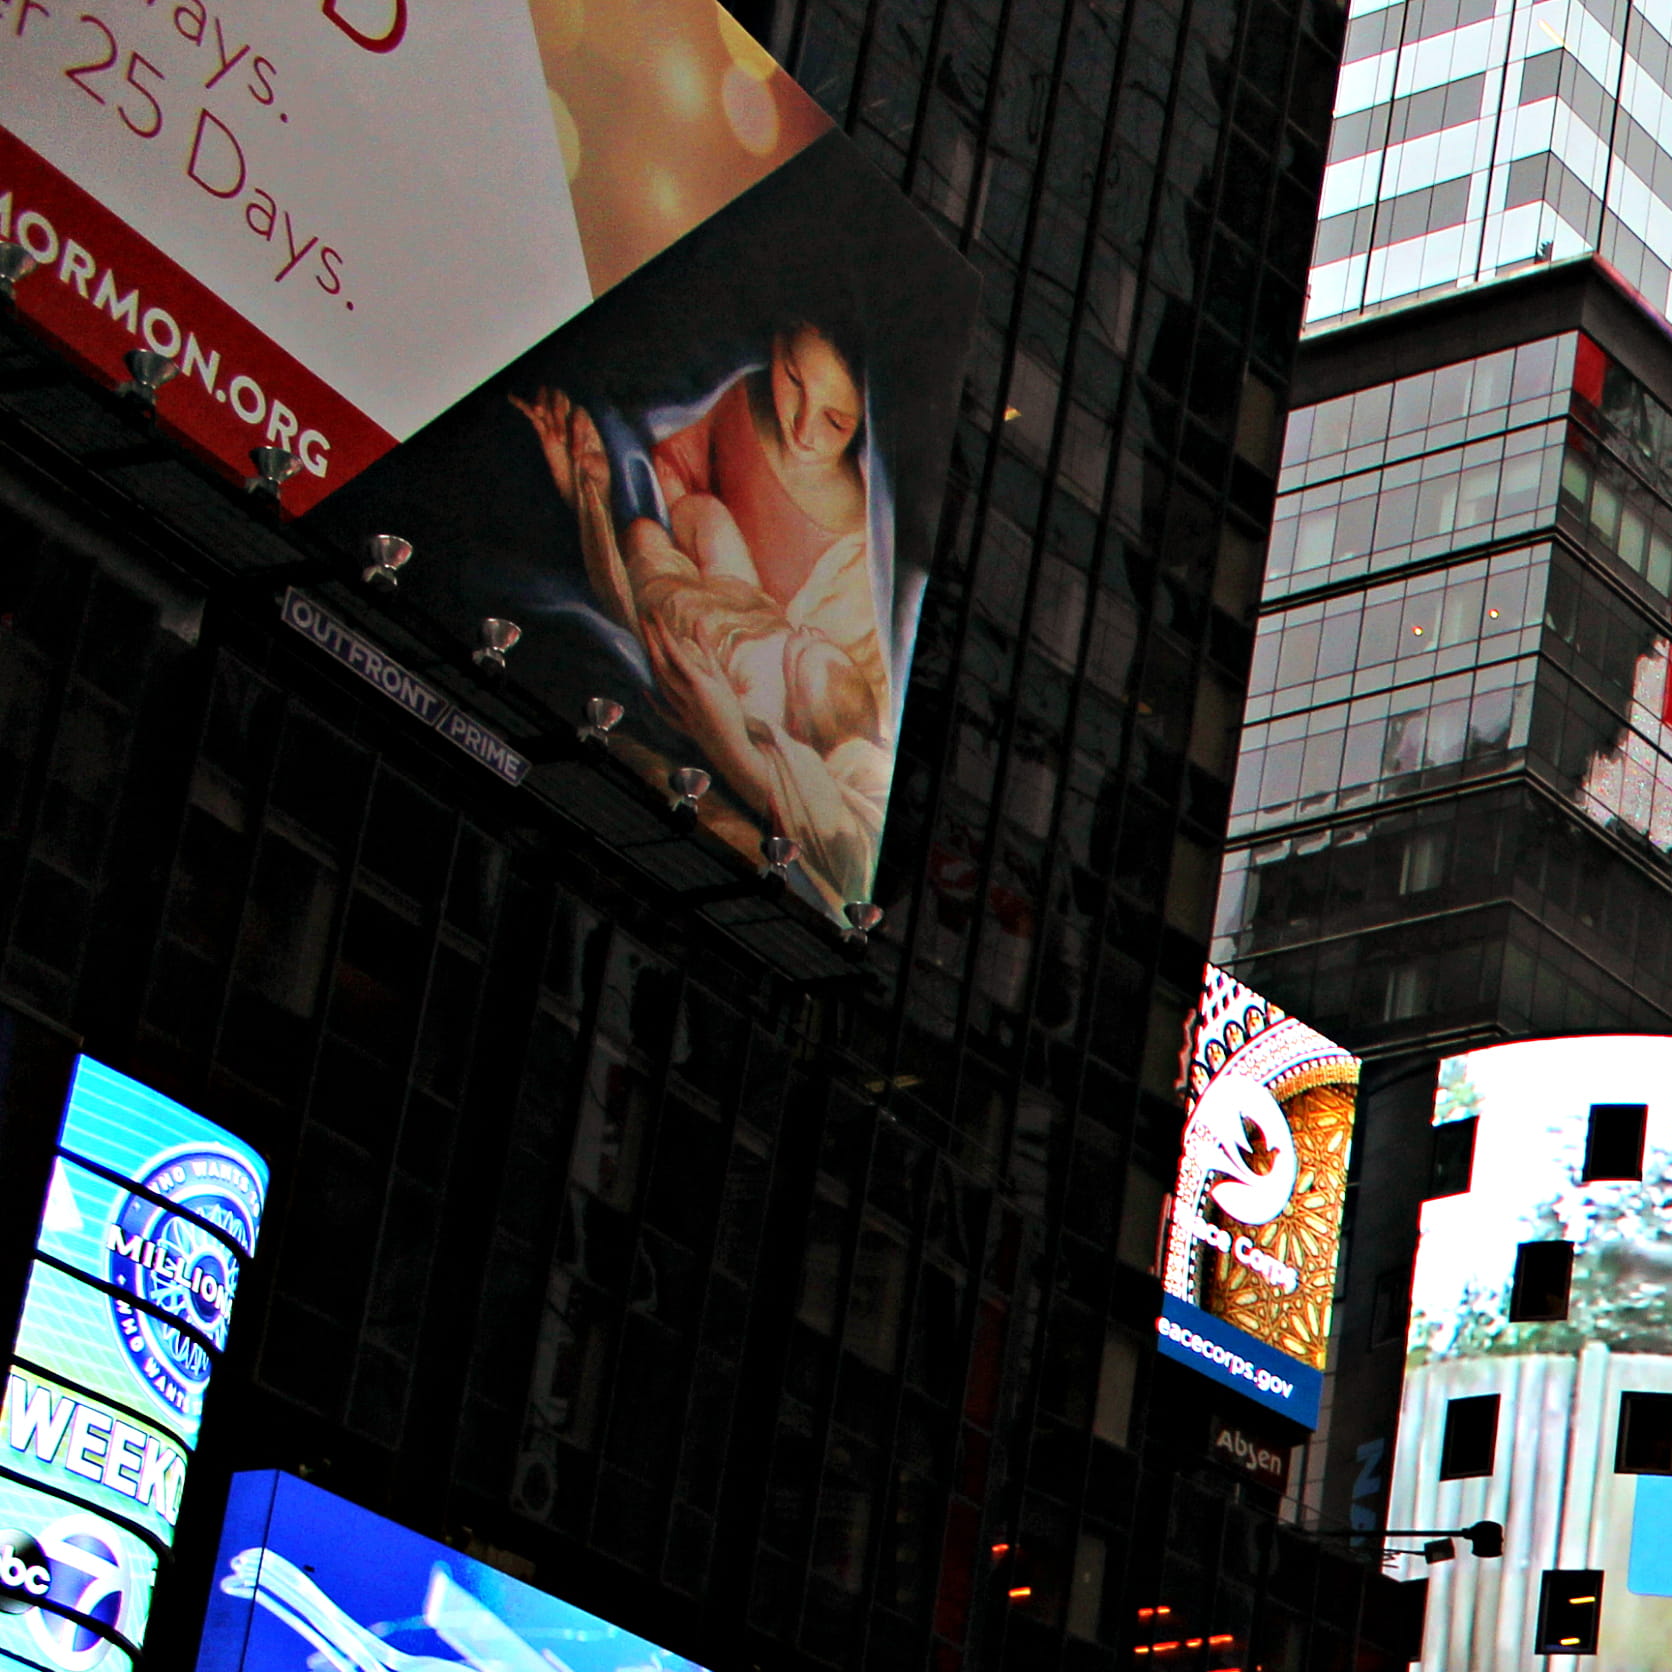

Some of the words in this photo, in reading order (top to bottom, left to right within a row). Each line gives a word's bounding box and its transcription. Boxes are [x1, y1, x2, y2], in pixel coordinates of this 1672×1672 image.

[146, 0, 289, 123] ays.
[64, 14, 166, 139] 25
[187, 107, 355, 312] Days.
[1233, 1234, 1300, 1295] Corps
